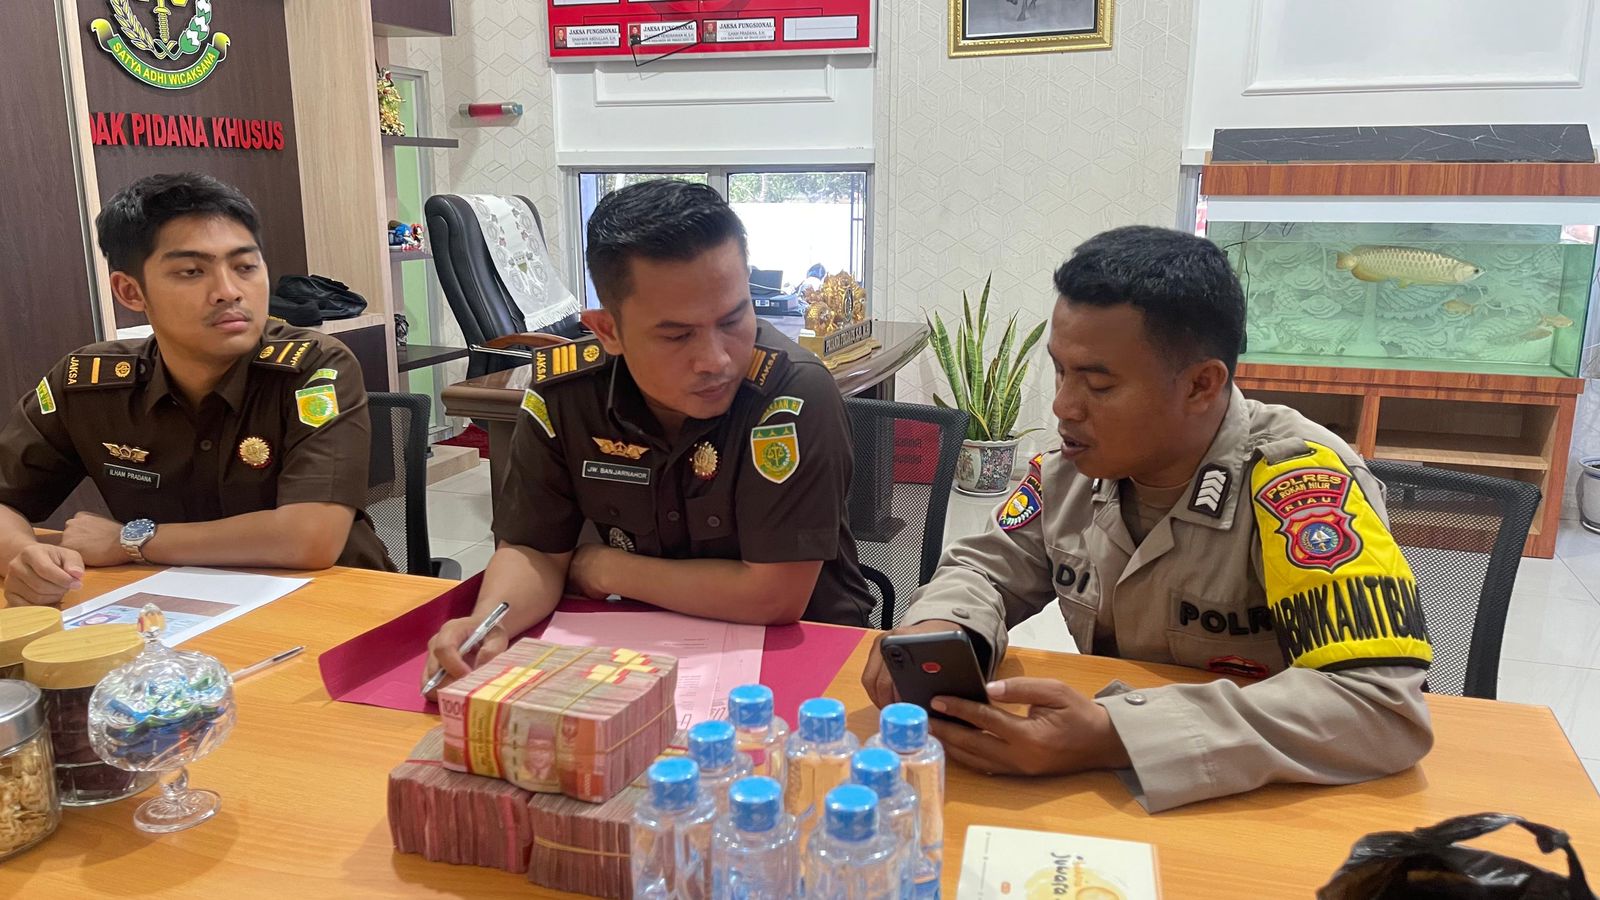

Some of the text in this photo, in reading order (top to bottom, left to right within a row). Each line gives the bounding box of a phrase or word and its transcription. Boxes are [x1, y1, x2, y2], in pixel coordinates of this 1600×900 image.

[113, 42, 216, 85] SATYA ADHI WICAKSANA
[131, 113, 209, 147] PIDANA
[212, 117, 285, 150] KHUSUS
[68, 356, 80, 385] JAKSA
[536, 351, 547, 381] JAKSA
[759, 352, 778, 386] JAKSA
[110, 469, 152, 482] ILHAM PRADANA
[600, 468, 647, 479] BANJARNAHOR
[1266, 474, 1342, 499] POLRES
[1279, 482, 1331, 499] ROKAN HILIR
[1285, 497, 1332, 512] RIAU
